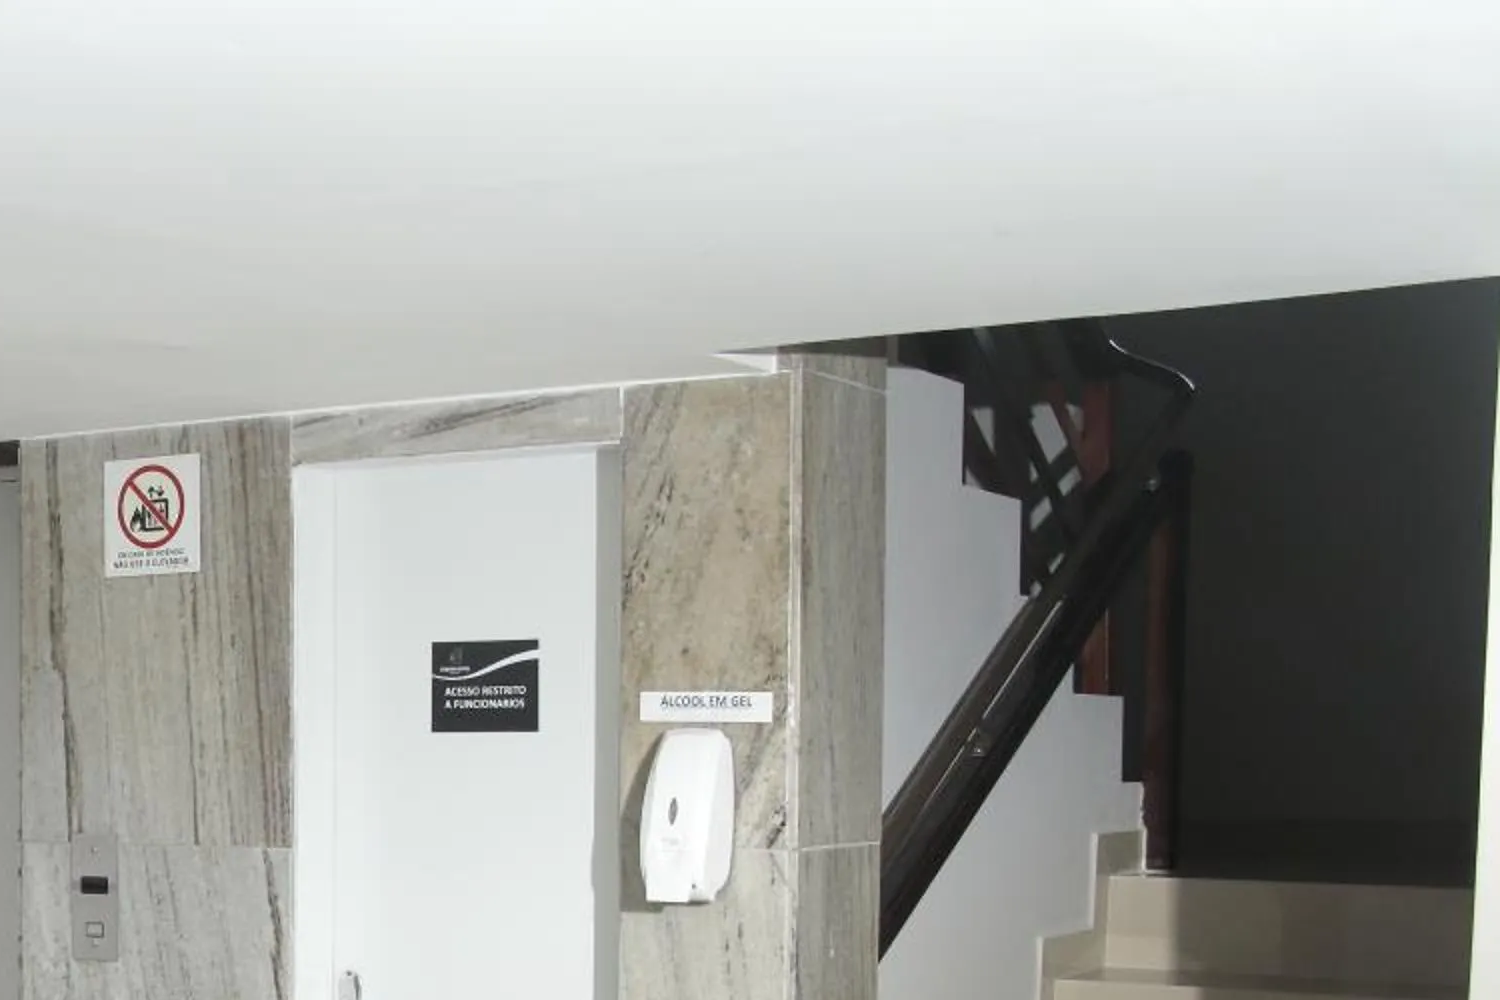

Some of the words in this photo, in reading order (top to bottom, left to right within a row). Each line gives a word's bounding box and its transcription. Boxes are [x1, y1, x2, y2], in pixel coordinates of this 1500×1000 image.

[443, 685, 480, 697] ACESSO
[481, 684, 527, 696] RESTRITO
[443, 699, 452, 709] A
[708, 695, 727, 708] EM
[731, 695, 753, 708] GEL
